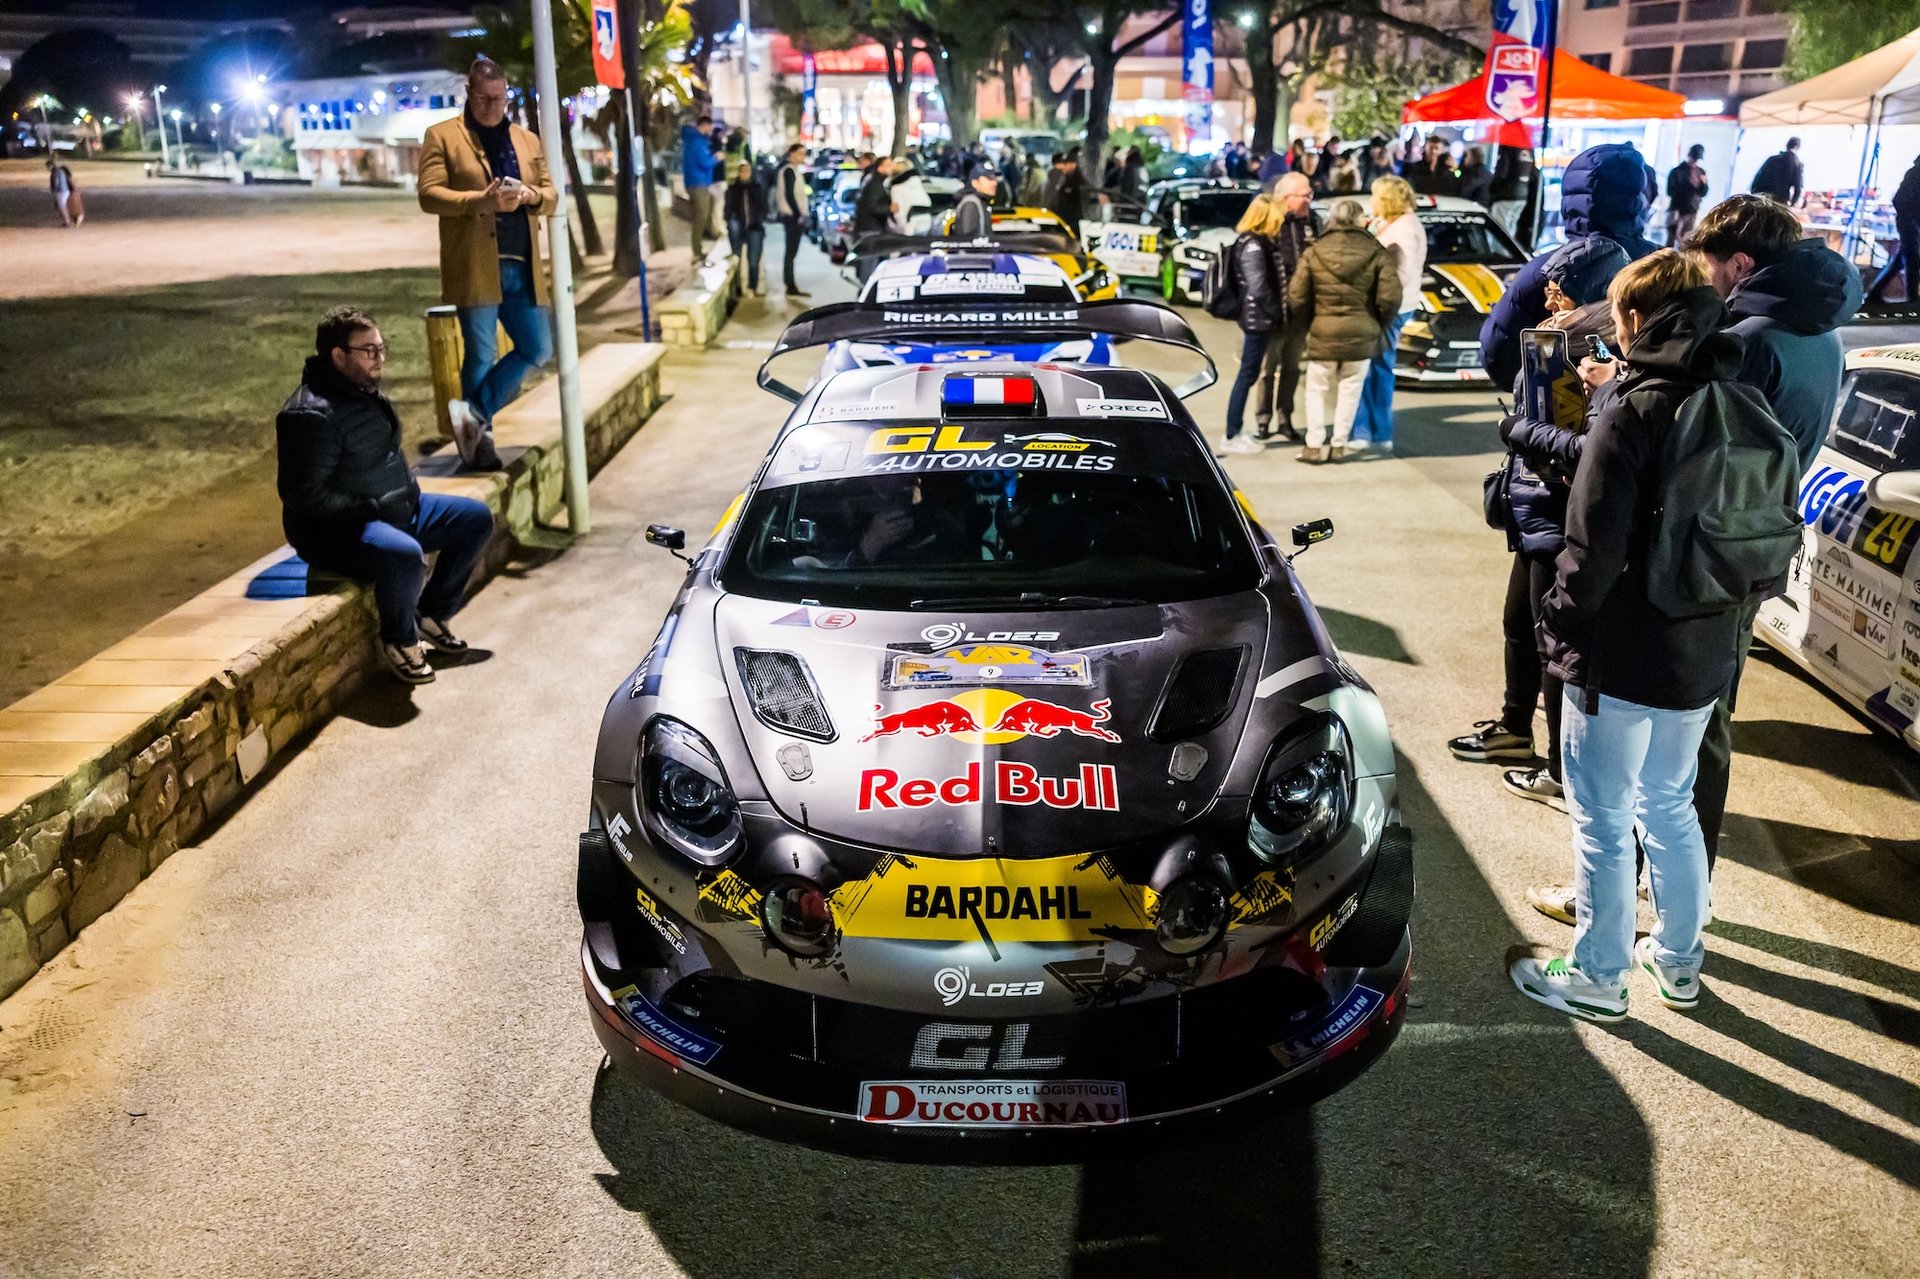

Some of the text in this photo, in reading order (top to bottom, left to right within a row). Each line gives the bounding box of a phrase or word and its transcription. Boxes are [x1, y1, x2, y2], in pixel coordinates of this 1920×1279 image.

[884, 310, 1079, 322] RICHARD MILLE
[1100, 404, 1162, 412] ORECA
[868, 426, 998, 453] GL
[1031, 443, 1082, 451] LOCATION
[863, 453, 1116, 472] AUTOMOBILES
[1799, 466, 1867, 545] IGOL
[1863, 511, 1915, 564] 29
[1806, 554, 1892, 618] NTE-MAXIME
[965, 631, 1060, 642] LOEB
[944, 646, 1037, 665] VAR
[1894, 680, 1920, 700] ALPIN
[856, 760, 1120, 813] Red Bull
[612, 835, 634, 863] PNEUS
[637, 888, 662, 921] GL
[637, 905, 687, 955] AUTOMOBILES
[905, 884, 1092, 962] BARDAHL
[1310, 913, 1337, 947] GL
[969, 981, 1045, 997] LOEB
[635, 1011, 705, 1053] MICHELIN
[1311, 995, 1369, 1045] MICHELIN
[909, 1023, 1066, 1070] GL
[865, 1085, 1121, 1123] DUCOURNAU
[919, 1085, 1119, 1096] TRANSPORTS et LOGISTIQUE
